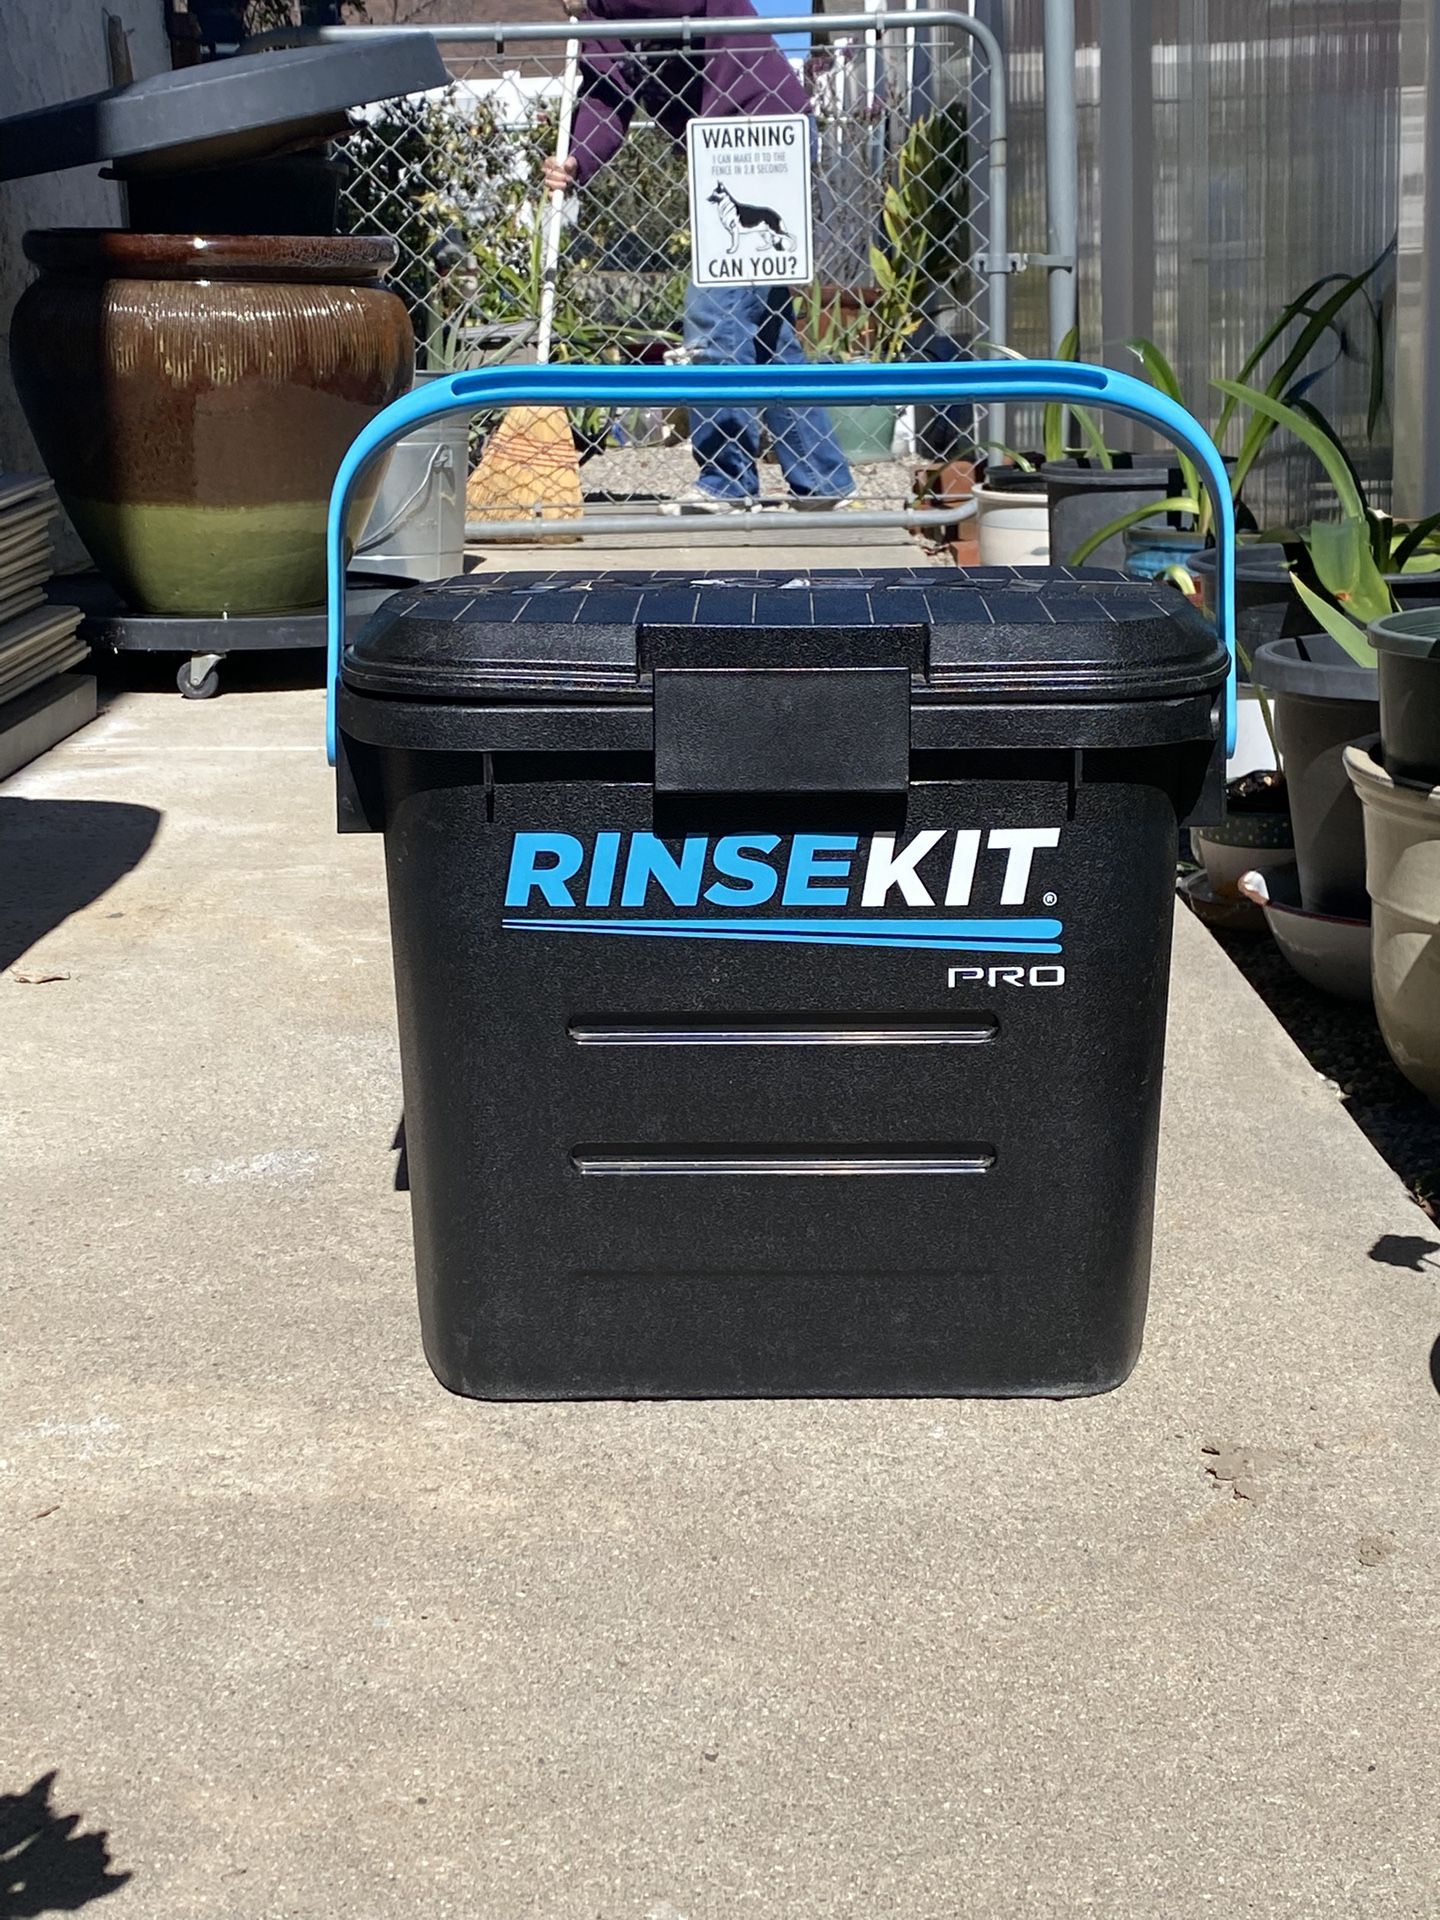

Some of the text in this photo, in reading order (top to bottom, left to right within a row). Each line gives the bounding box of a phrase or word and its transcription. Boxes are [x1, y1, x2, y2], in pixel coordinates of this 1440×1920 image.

[702, 126, 795, 149] WARNING
[717, 154, 731, 164] CAN
[733, 153, 752, 163] MAKE
[754, 152, 761, 162] IT
[762, 152, 771, 162] TO
[773, 152, 786, 162] THE
[711, 165, 732, 176] FENCE
[734, 165, 742, 175] IN
[756, 163, 788, 174] SECONDS
[708, 256, 797, 278] CAN YOU?
[503, 827, 1061, 908] RINSEKIT
[948, 965, 1066, 988] PRO
